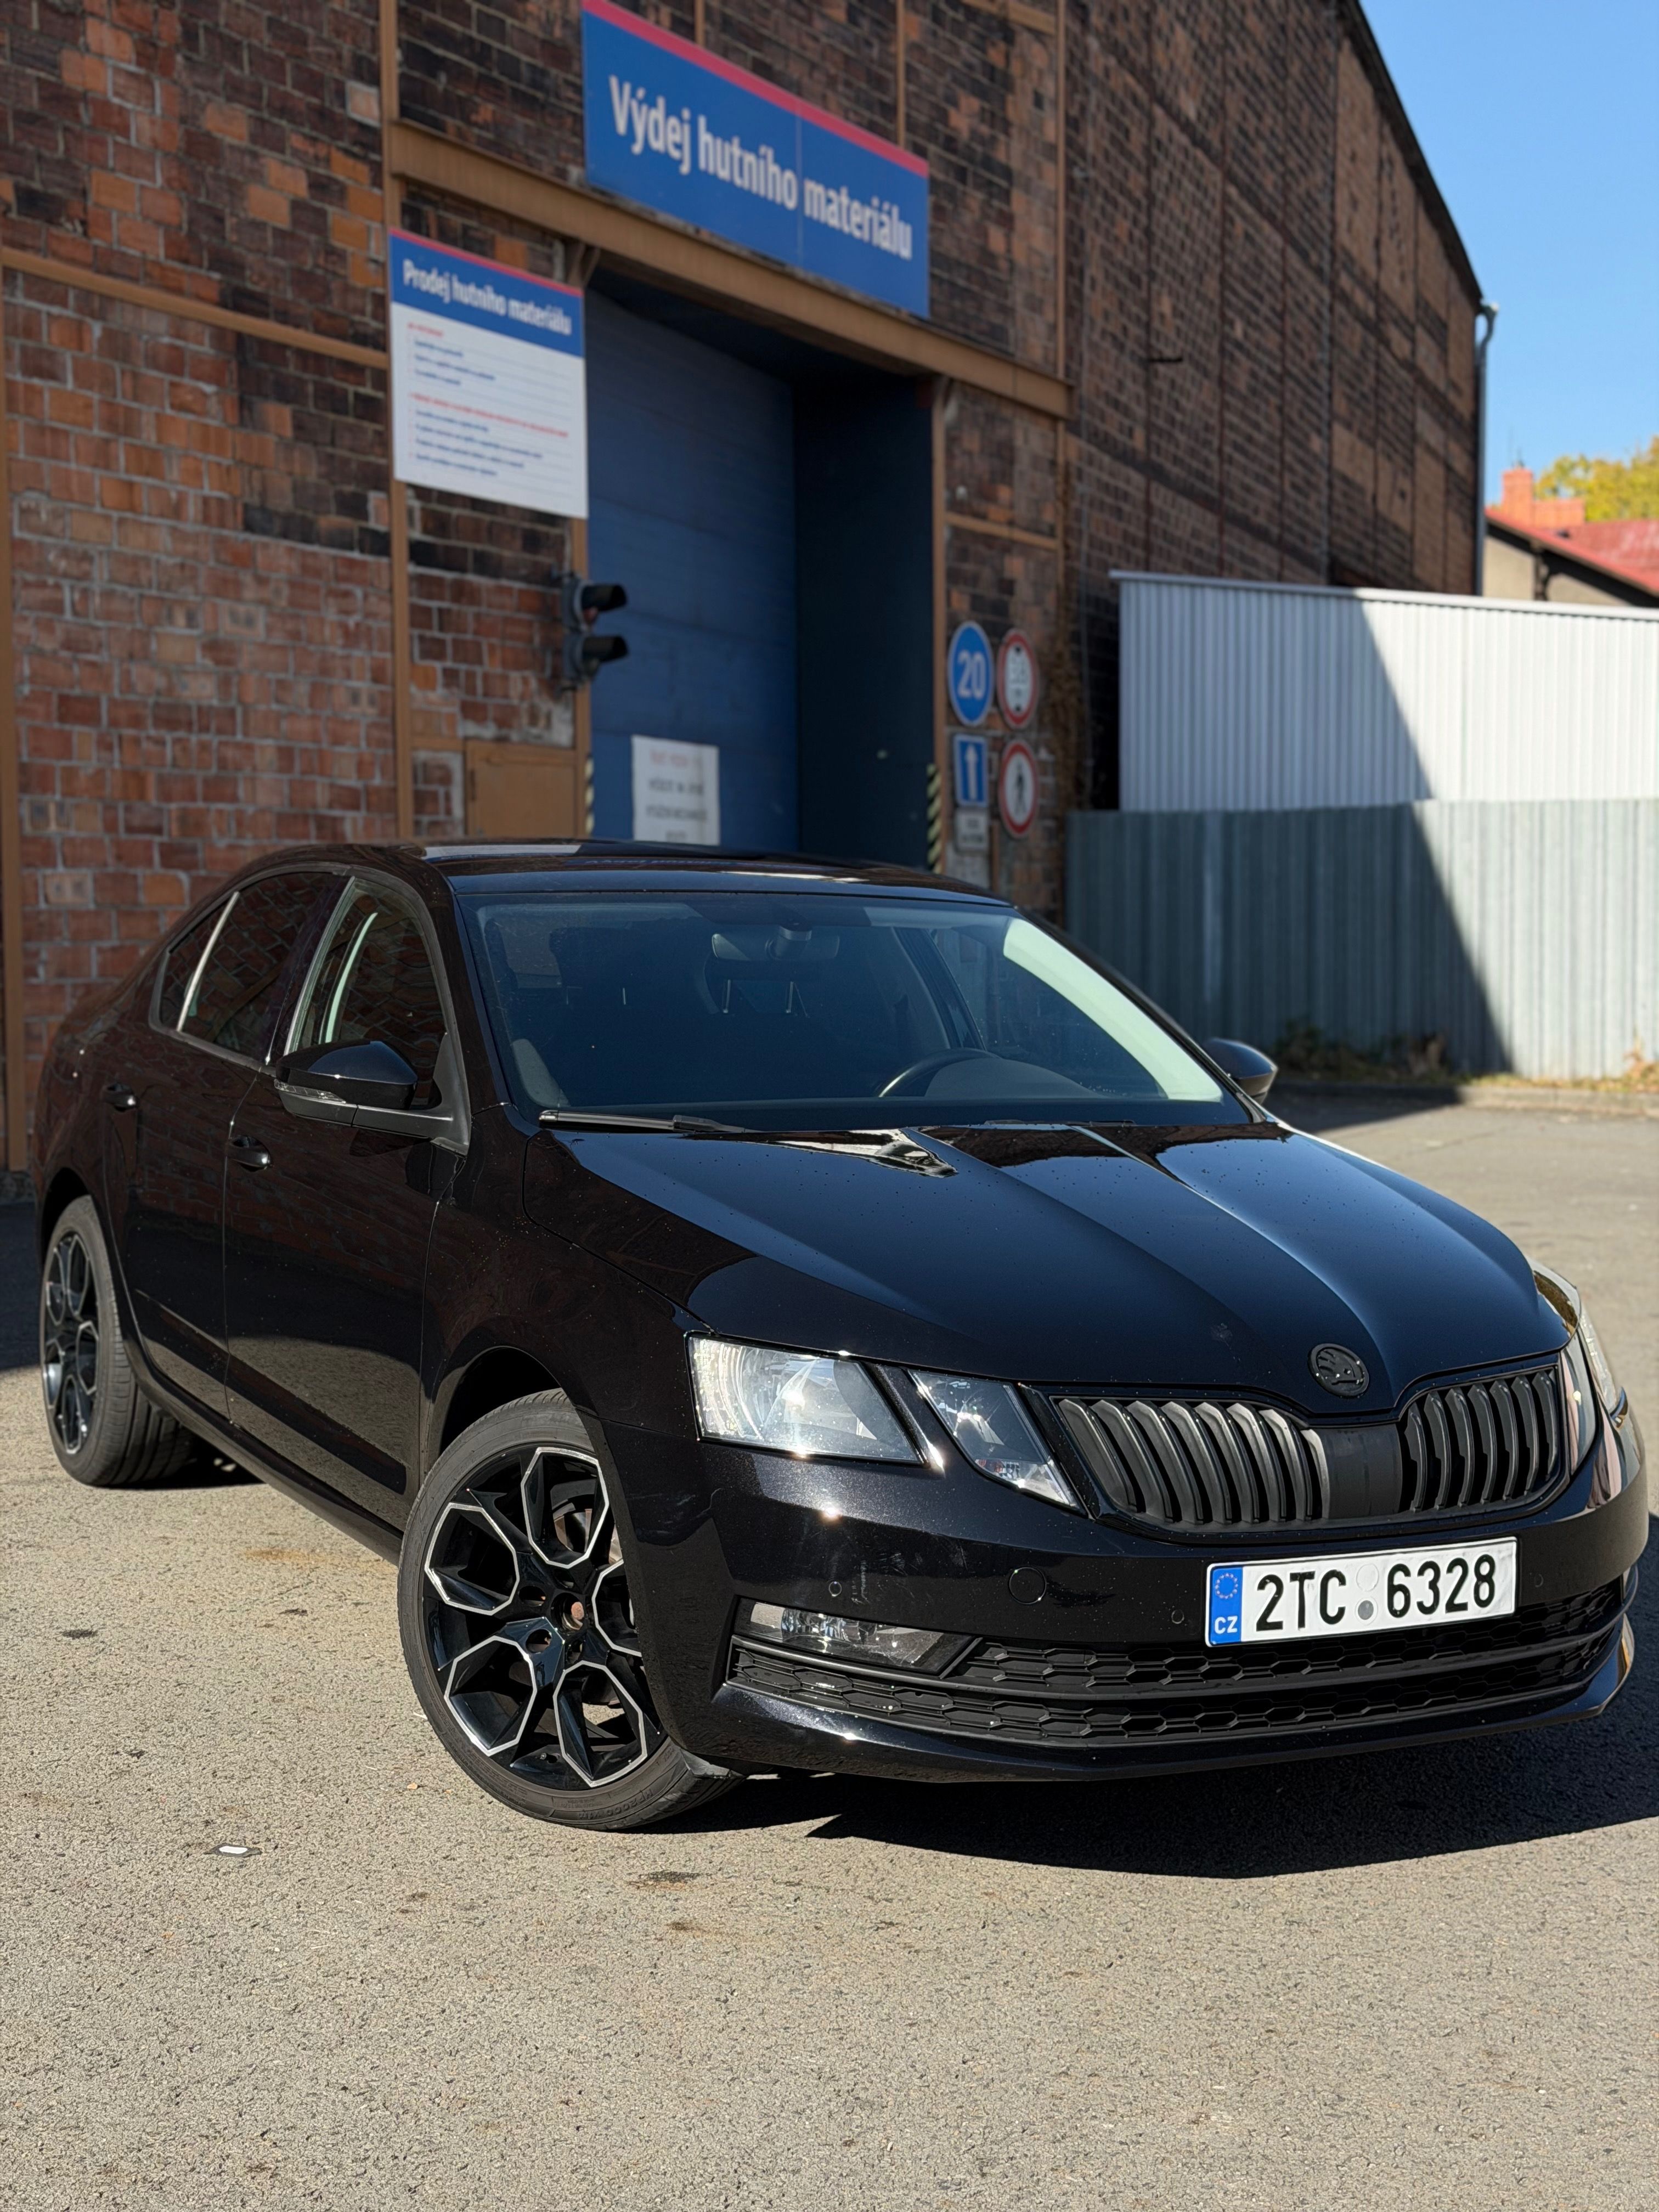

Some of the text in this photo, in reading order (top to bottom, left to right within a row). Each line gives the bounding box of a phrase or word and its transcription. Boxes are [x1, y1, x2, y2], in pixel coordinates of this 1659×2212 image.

[609, 75, 913, 261] Výdej hutního materiálu
[403, 259, 451, 304] Prodej
[957, 650, 986, 701] 20
[1256, 1554, 1496, 1632] 2TC 6328
[1214, 1615, 1238, 1634] CZ
